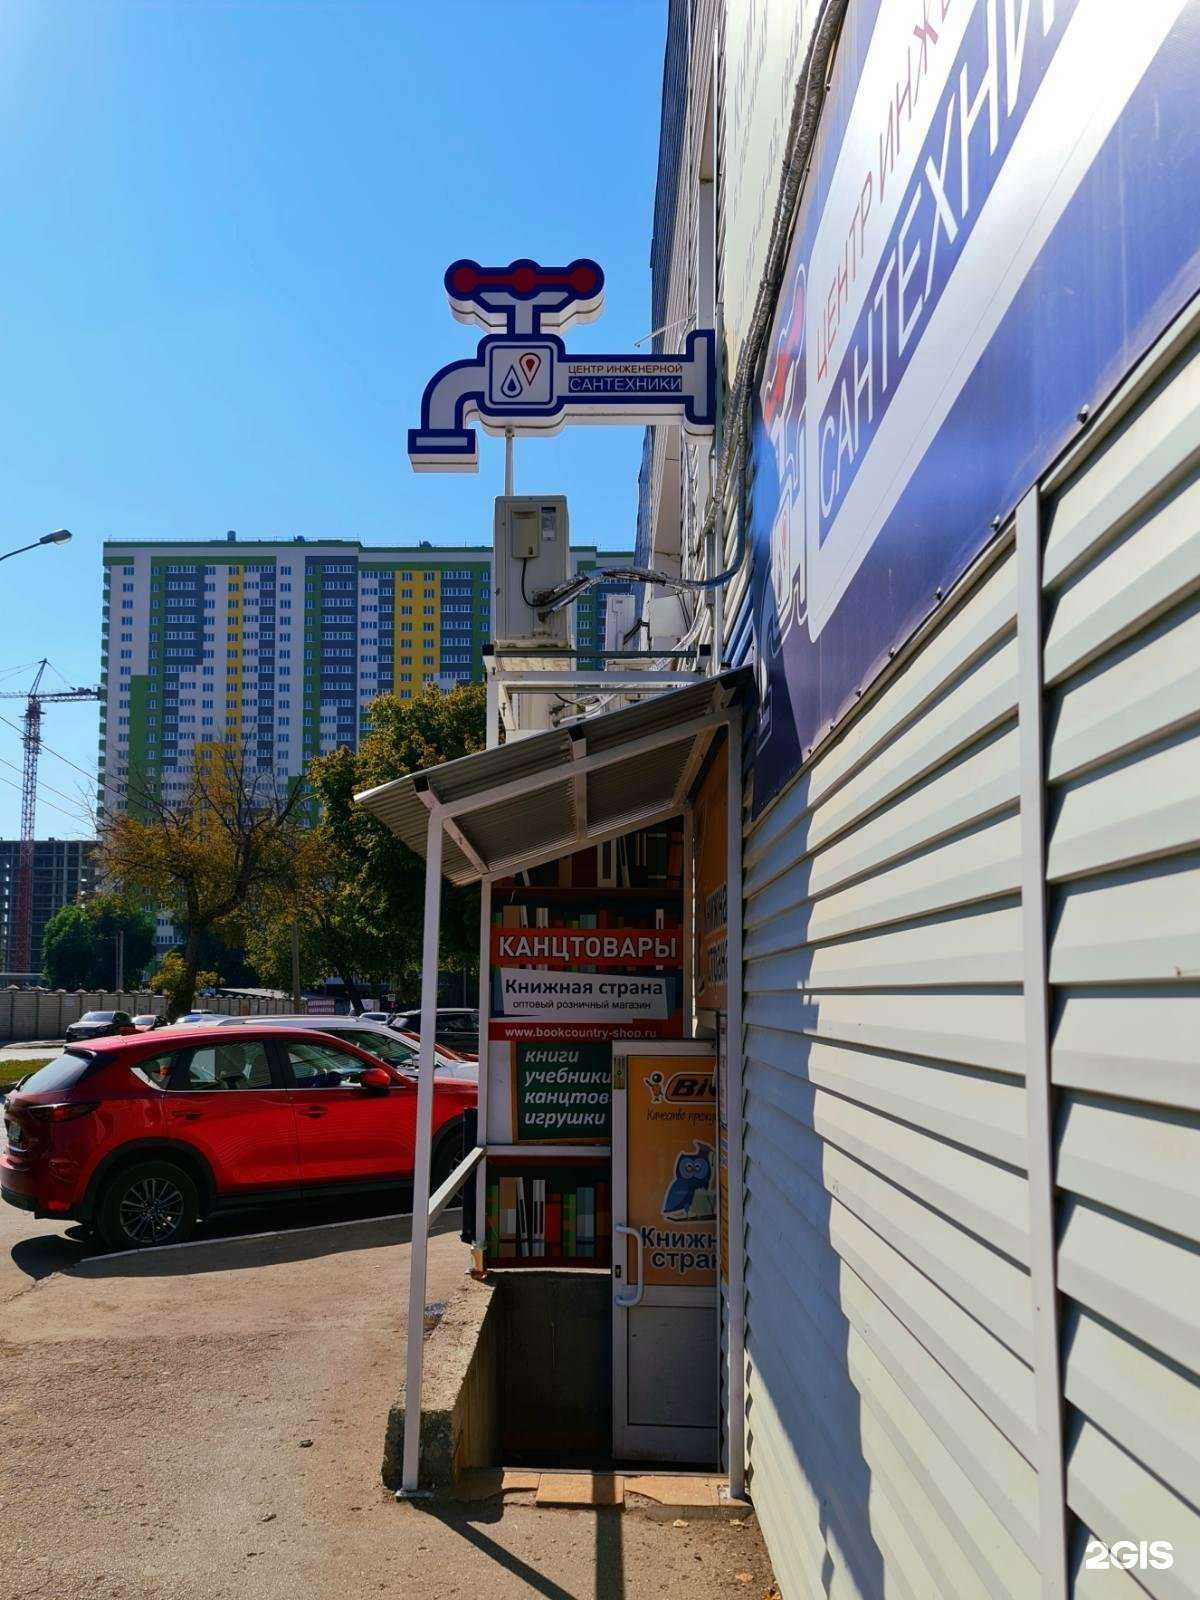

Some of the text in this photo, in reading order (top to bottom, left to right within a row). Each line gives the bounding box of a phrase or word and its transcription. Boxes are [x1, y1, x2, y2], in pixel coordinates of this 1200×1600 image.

[816, 0, 951, 384] ЦЕНТР ИНЖ
[568, 362, 683, 375] ЦЕНТР ИНЖЕНЕРНОЙ
[570, 377, 682, 392] САНТЕХНИКИ
[499, 936, 677, 962] КАНЦТОВАРЫ
[505, 978, 664, 998] Книжная страна
[512, 999, 652, 1011] оптовый розничный магазин
[504, 1026, 657, 1040] www.bookcountry-shop.ru
[524, 1050, 579, 1063] книги
[524, 1067, 612, 1087] учебники
[524, 1112, 606, 1129] игрушки
